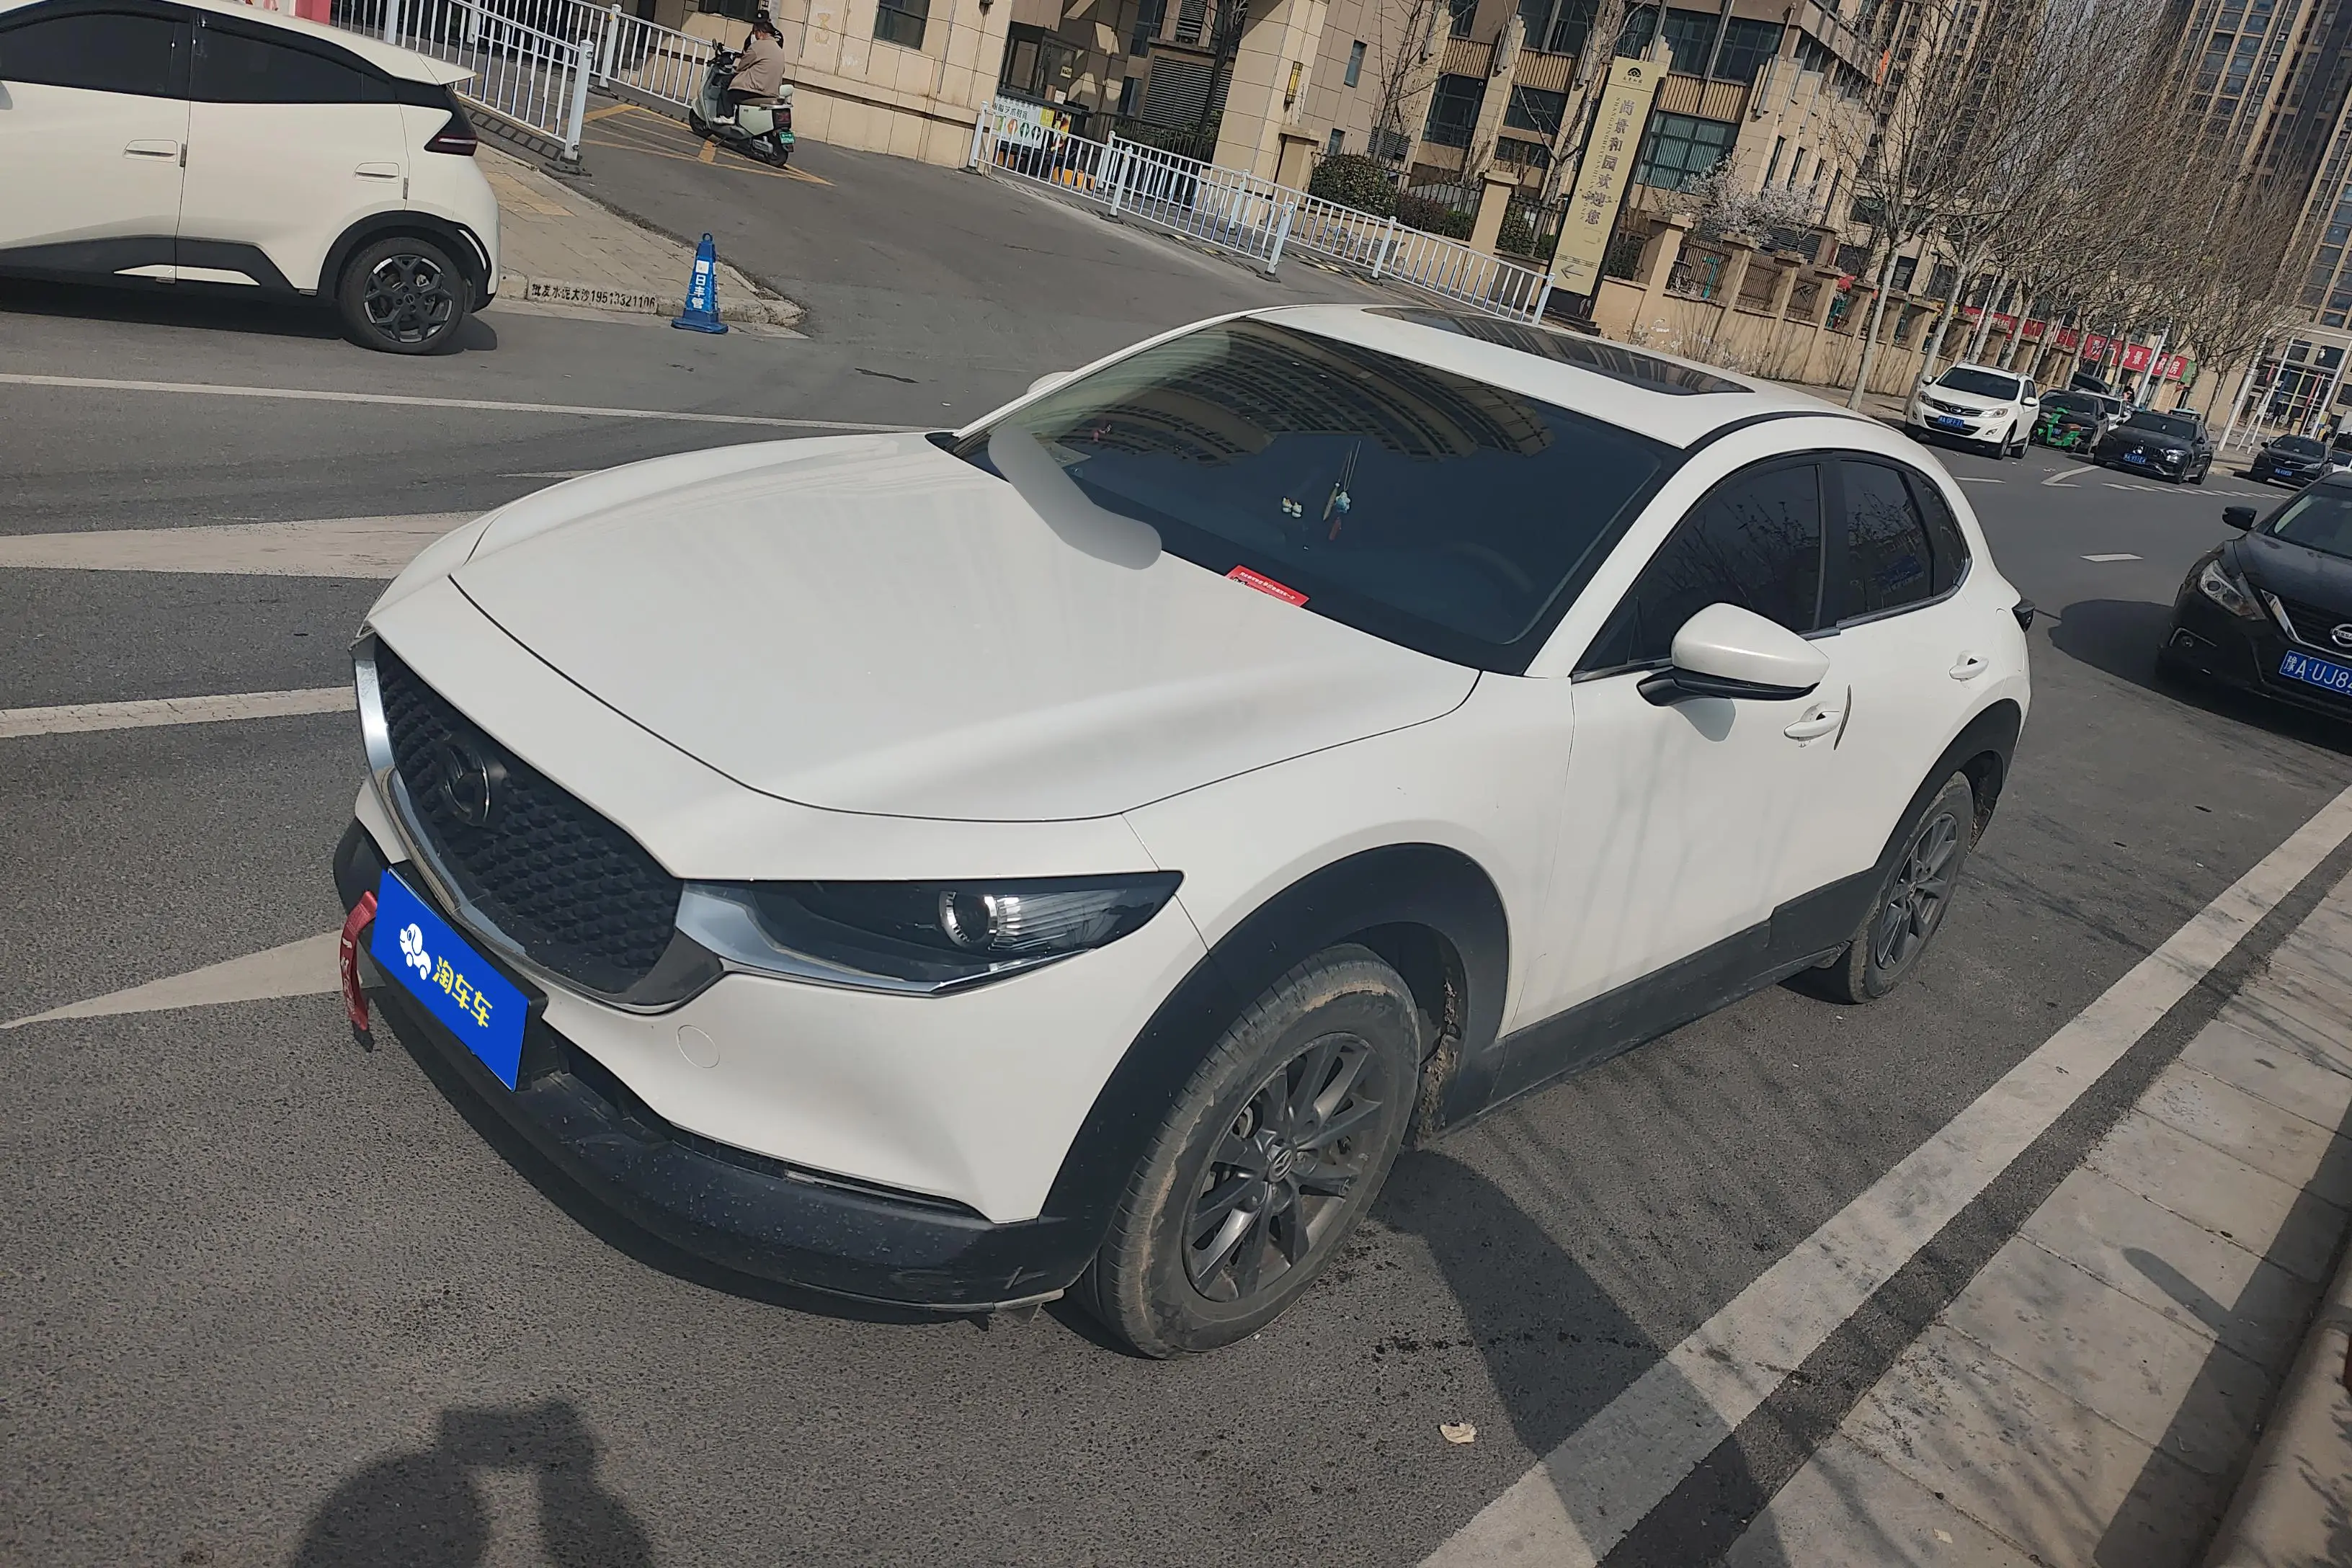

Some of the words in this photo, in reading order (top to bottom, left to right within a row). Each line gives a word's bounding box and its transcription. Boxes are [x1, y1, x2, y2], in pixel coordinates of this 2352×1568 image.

[1585, 99, 1635, 225] 尚景和园欢迎您
[692, 274, 706, 309] 日丰管
